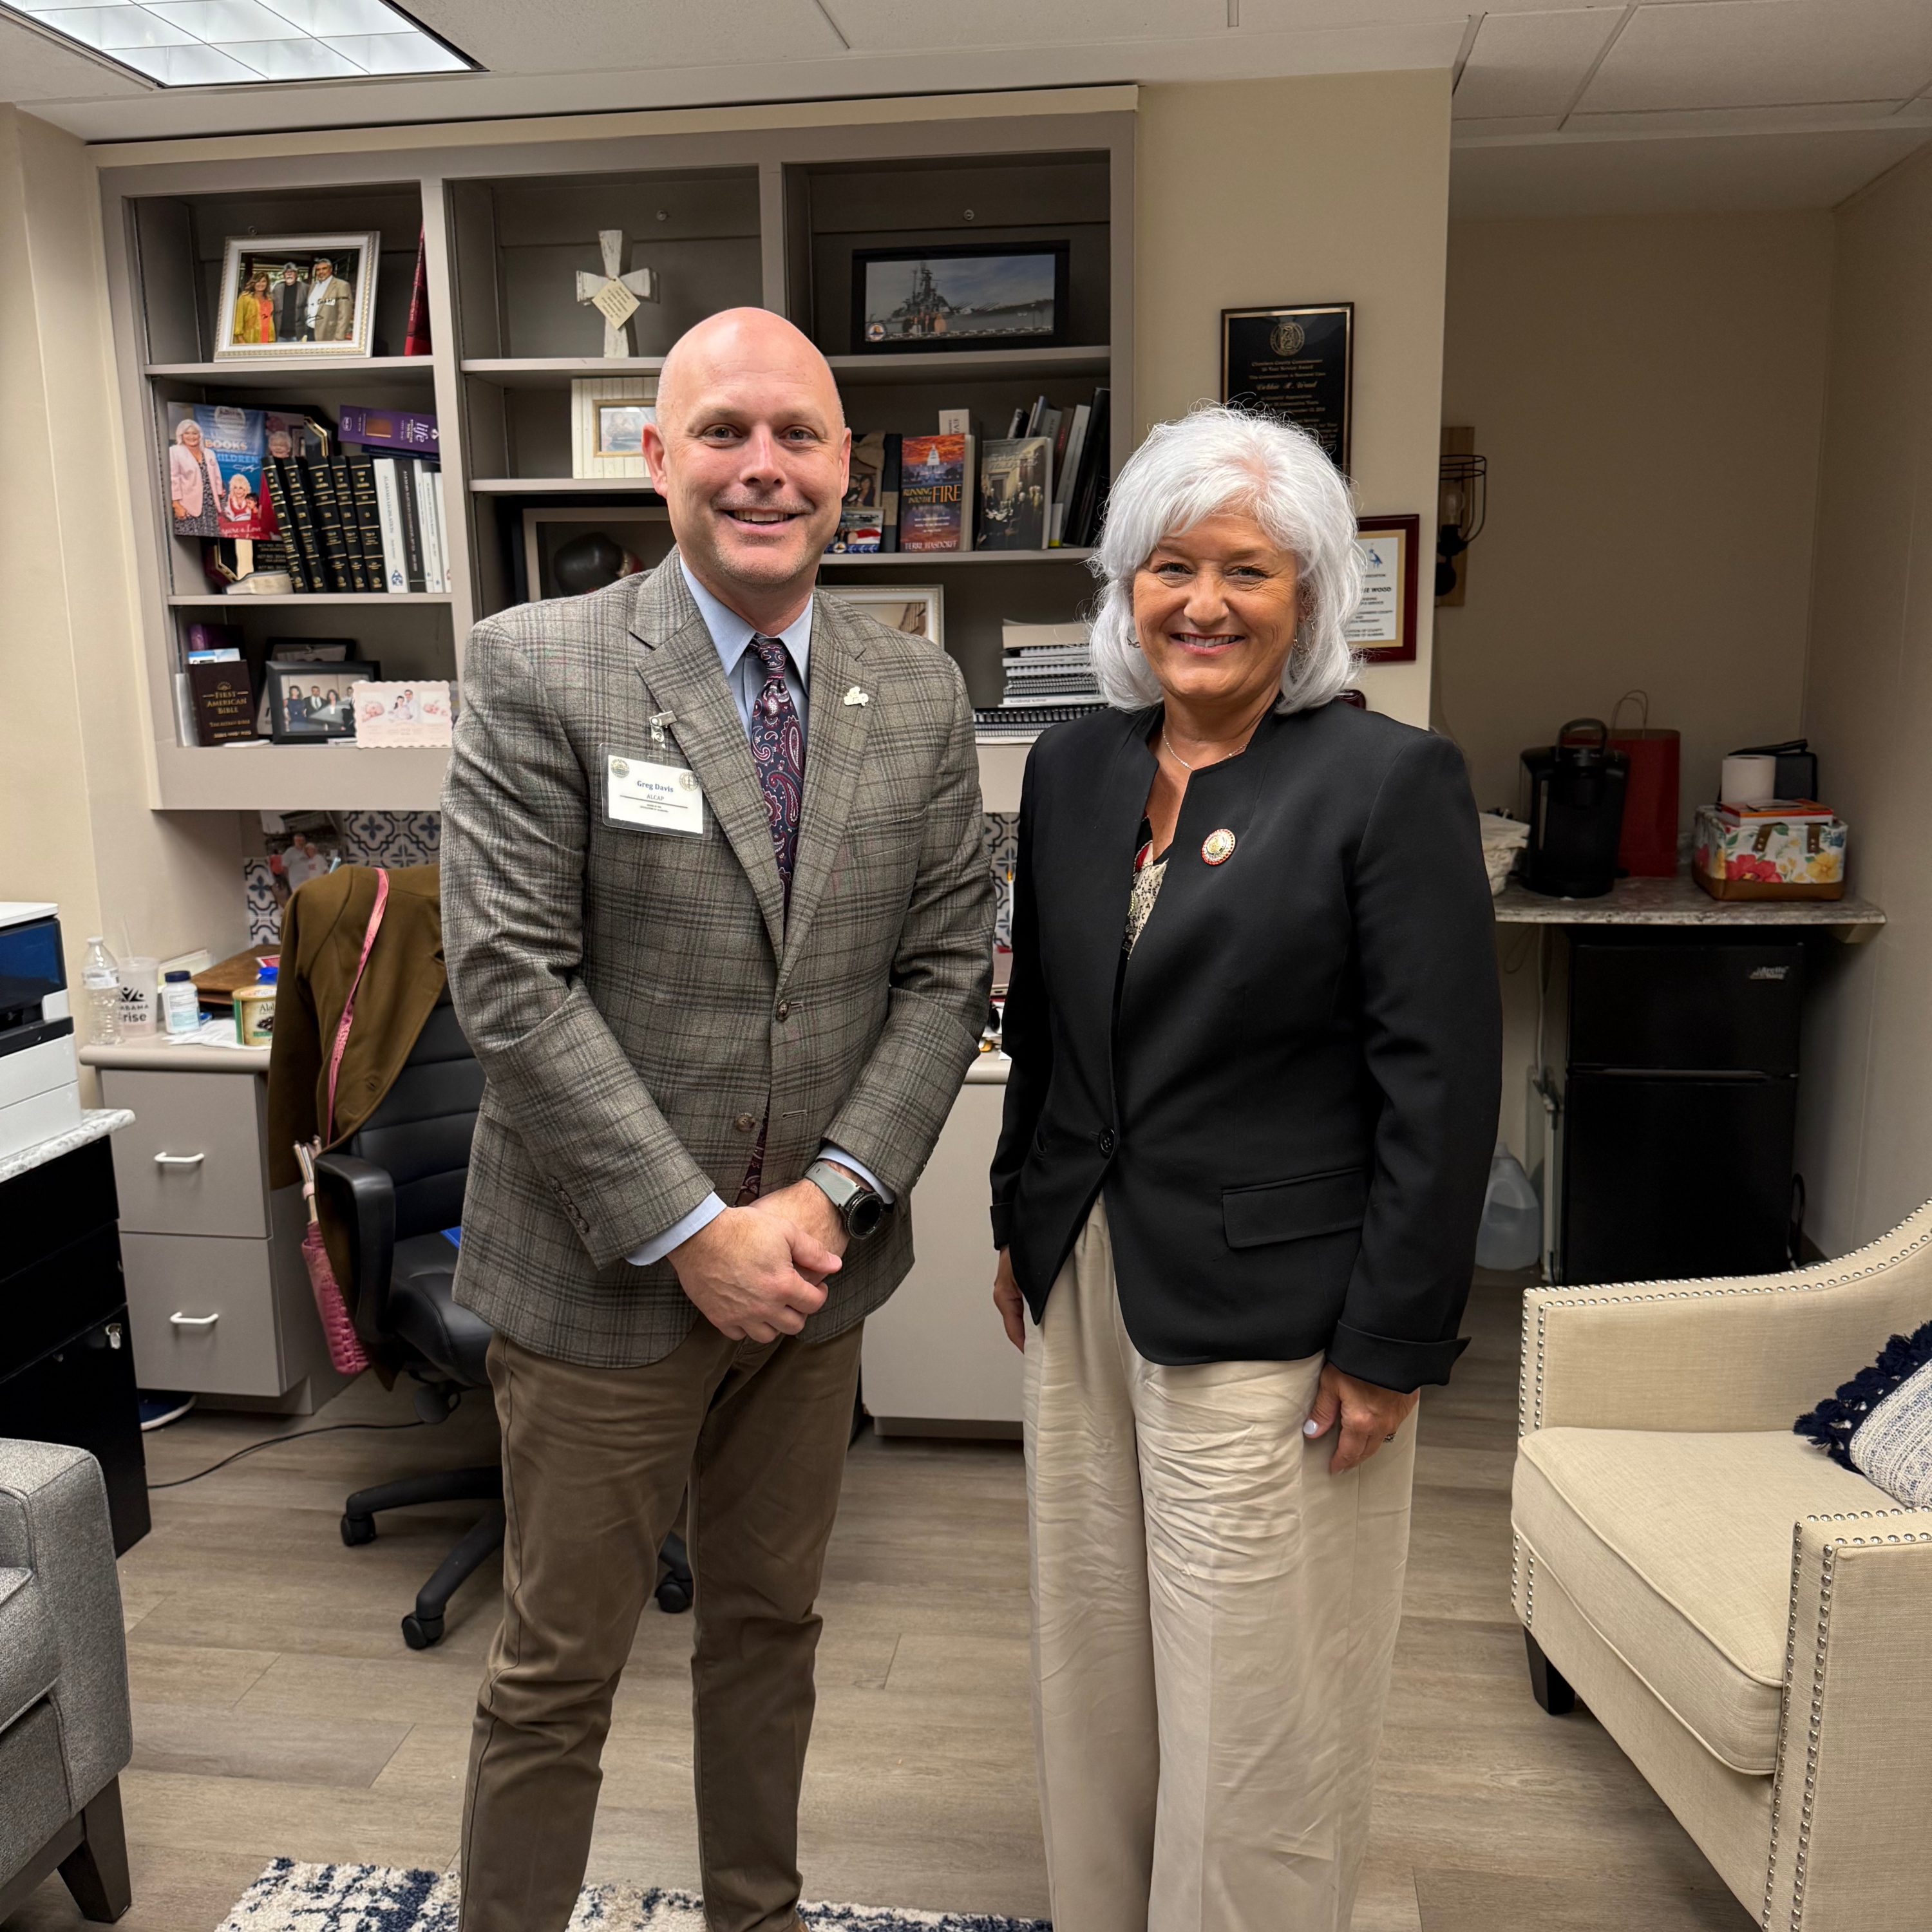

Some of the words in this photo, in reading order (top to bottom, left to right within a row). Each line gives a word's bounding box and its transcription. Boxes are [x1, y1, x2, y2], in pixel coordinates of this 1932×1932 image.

[413, 422, 429, 443] life
[205, 439, 248, 451] BOOKS
[932, 484, 962, 504] FIRE
[207, 697, 247, 708] AMERICAN
[637, 780, 654, 791] Greg
[655, 783, 674, 793] Davis
